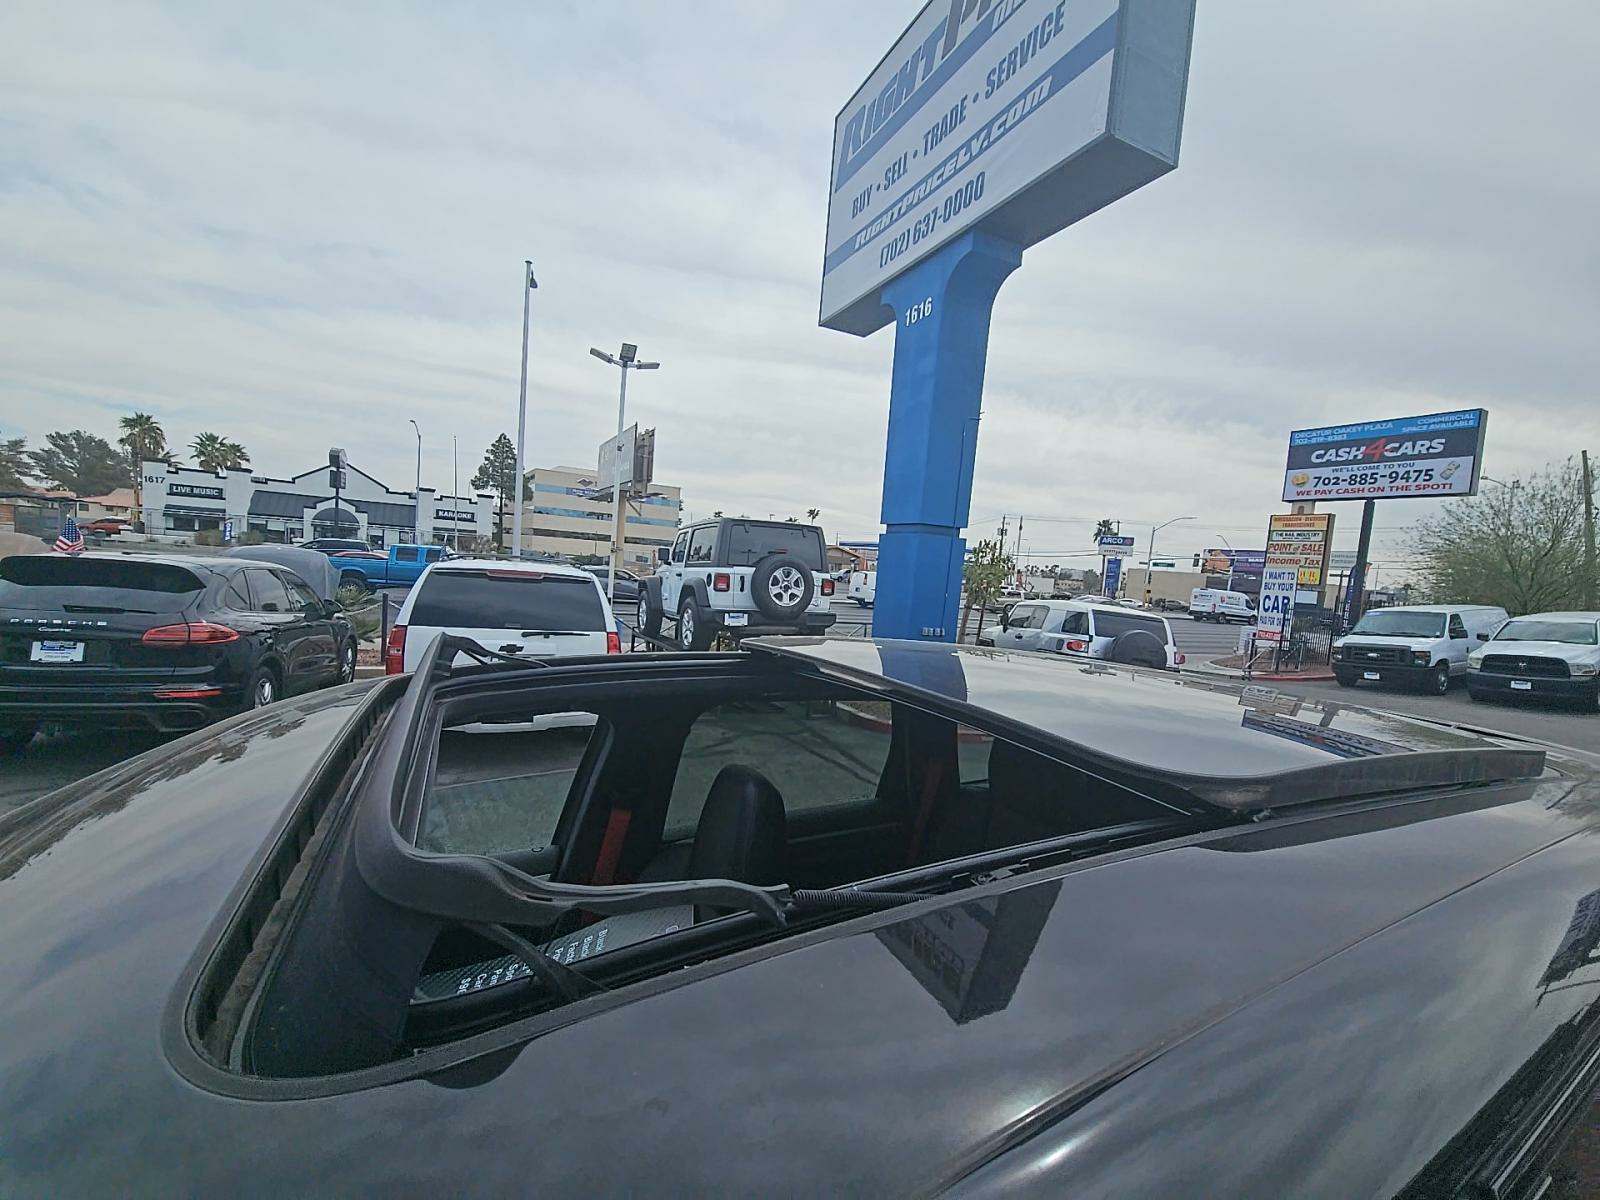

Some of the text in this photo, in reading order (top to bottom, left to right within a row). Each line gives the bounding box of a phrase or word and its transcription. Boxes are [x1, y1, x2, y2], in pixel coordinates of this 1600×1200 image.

[840, 14, 949, 164] RIGHT
[851, 184, 873, 220] BUY
[884, 151, 908, 192] SELL
[923, 94, 968, 157] TRADE
[985, 3, 1066, 100] SERVICE
[879, 171, 986, 269] (702) 637-0000
[905, 297, 933, 327] 1616
[1417, 413, 1476, 425] COMMERCIAL
[1364, 422, 1393, 432] PLAZA
[1397, 461, 1416, 469] YOU
[144, 475, 165, 484] 1617
[1312, 468, 1434, 488] 702-885-9475
[172, 486, 219, 496] LIVE MUSIC
[1296, 482, 1453, 497] WE PAY CASH ON THE SPOT!
[1102, 537, 1123, 545] ARCO
[1268, 544, 1292, 552] POINT
[1301, 543, 1323, 552] SALE
[1266, 556, 1301, 566] Income
[1303, 556, 1321, 566] Tax
[1268, 571, 1286, 580] WANT
[1287, 571, 1295, 581] TO
[1263, 582, 1276, 591] BUY
